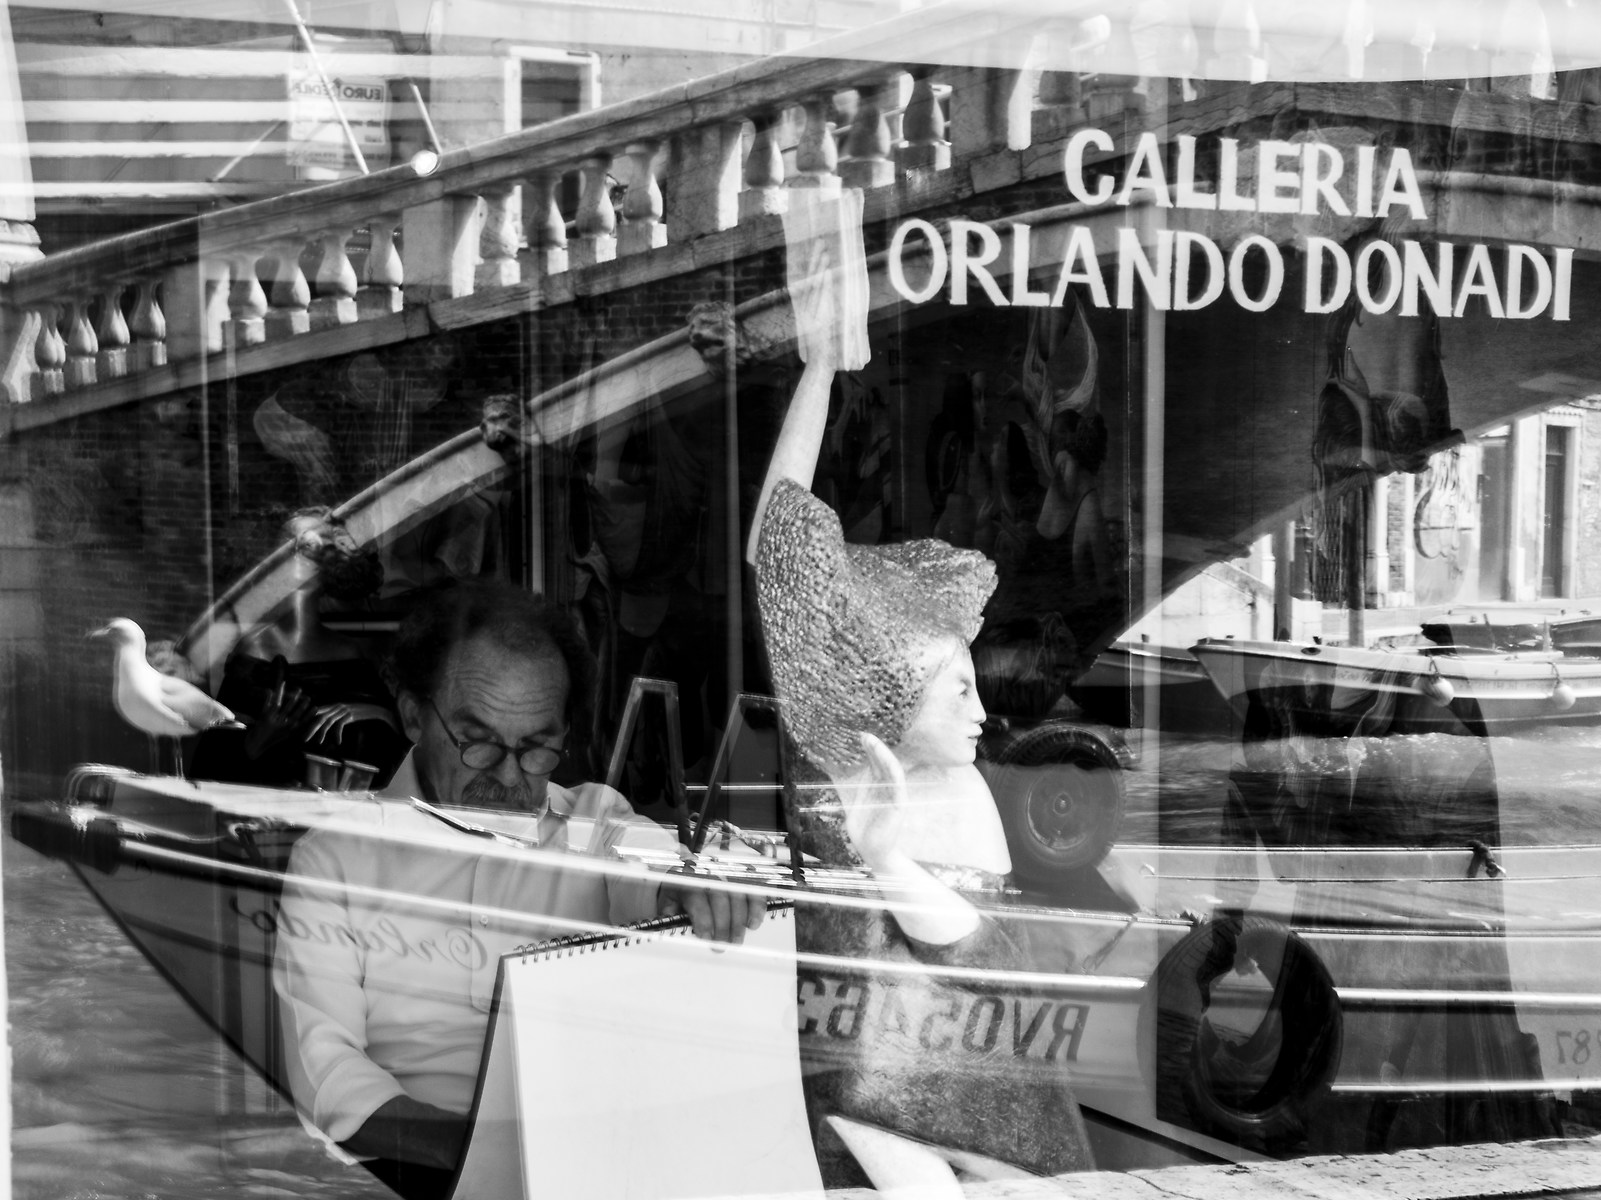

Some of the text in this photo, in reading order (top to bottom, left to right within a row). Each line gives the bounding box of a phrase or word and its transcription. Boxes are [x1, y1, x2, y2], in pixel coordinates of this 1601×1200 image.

[1064, 128, 1428, 220] GALLERIA
[888, 217, 1574, 322] ORLANDO DONADI
